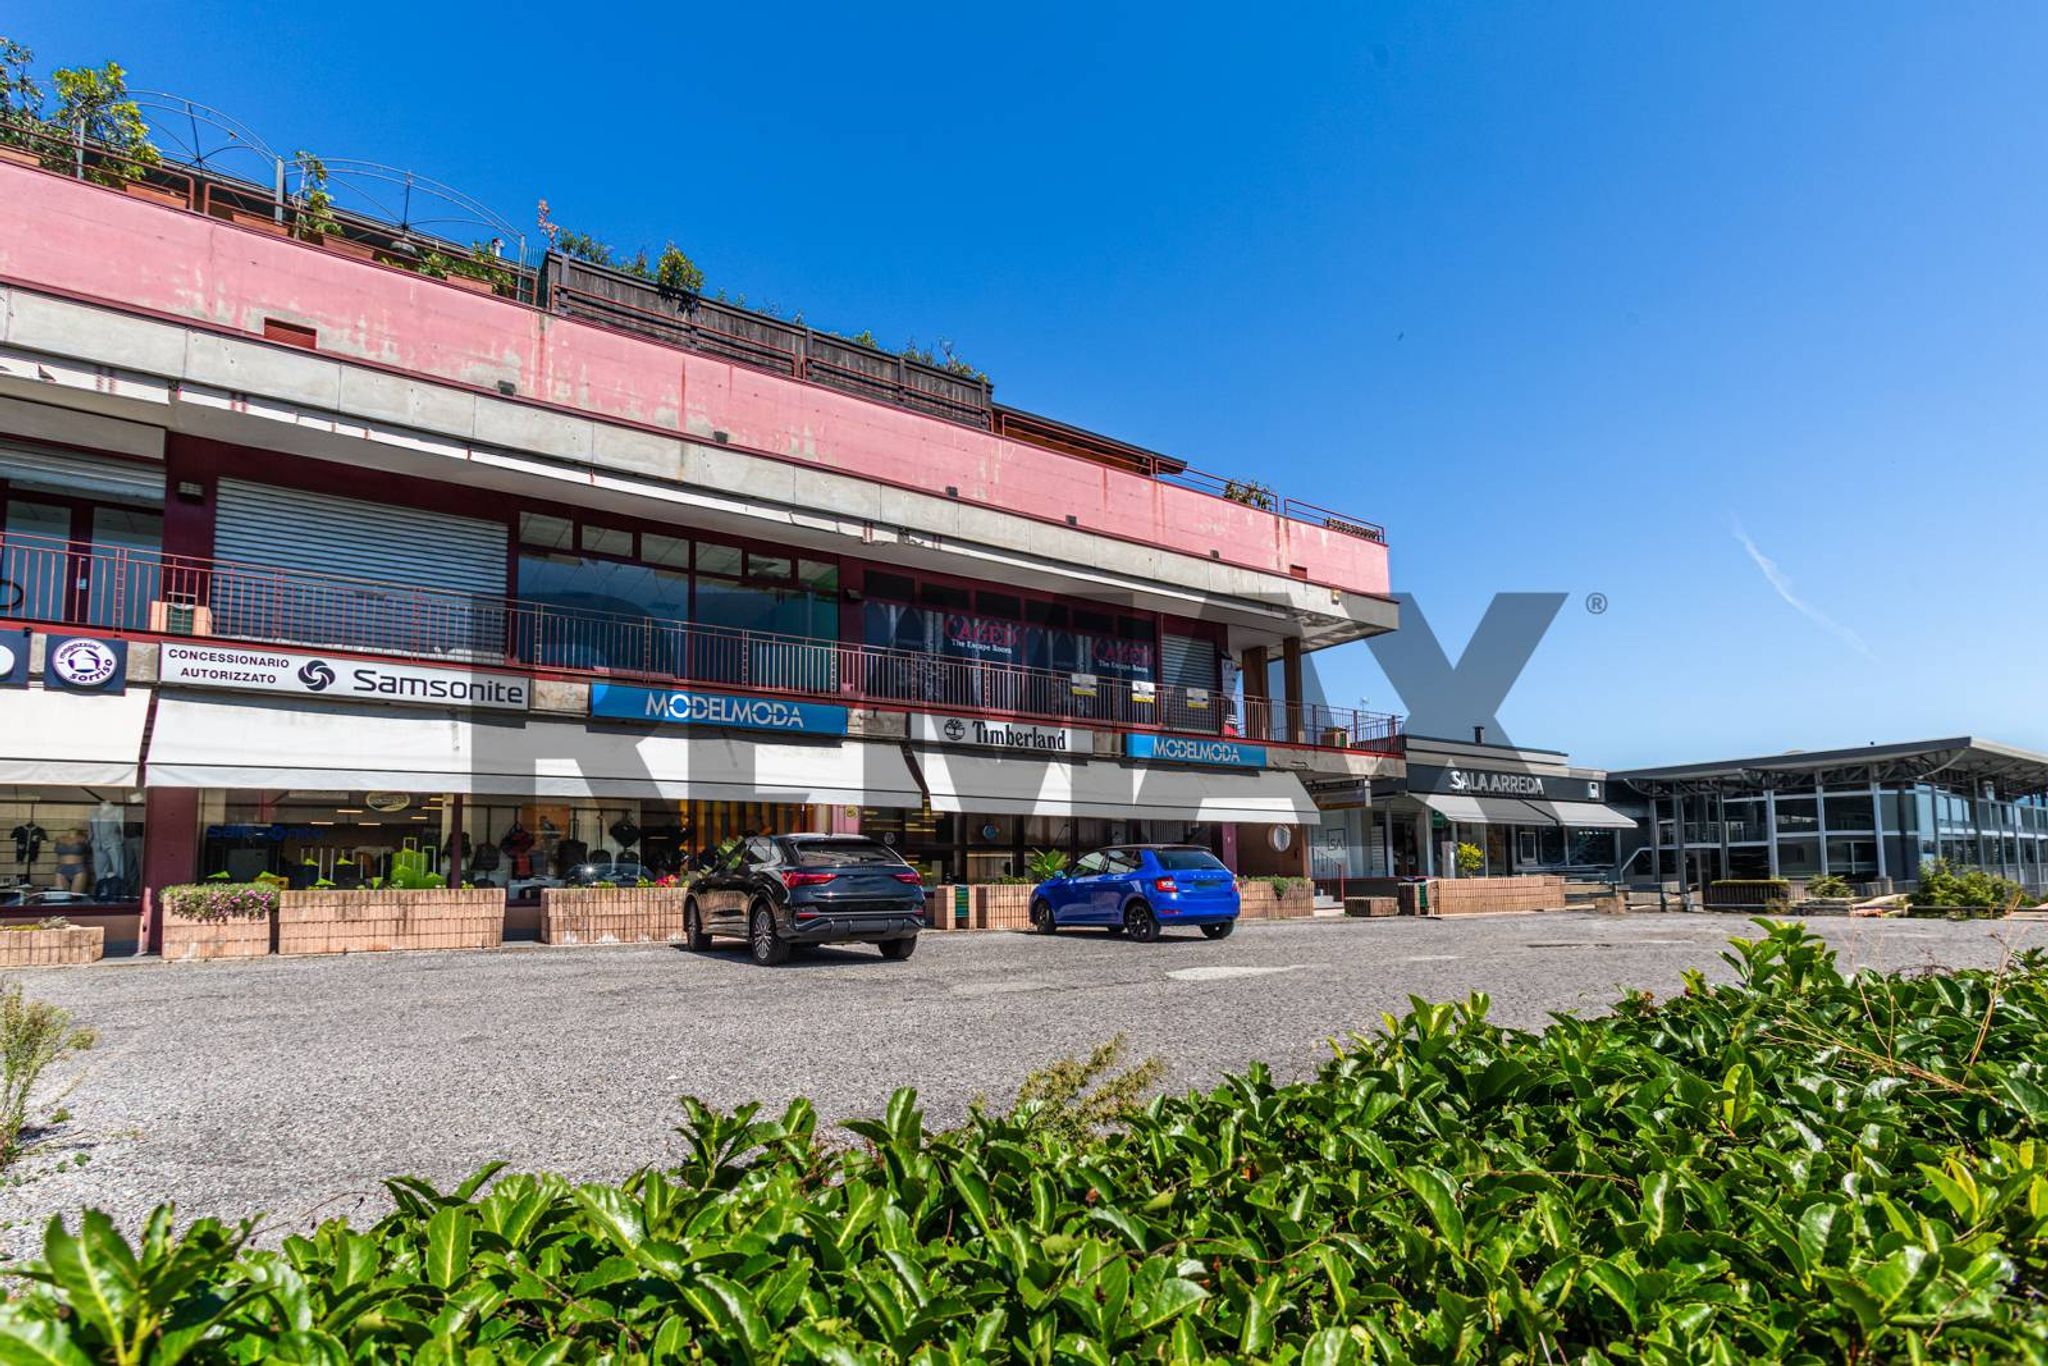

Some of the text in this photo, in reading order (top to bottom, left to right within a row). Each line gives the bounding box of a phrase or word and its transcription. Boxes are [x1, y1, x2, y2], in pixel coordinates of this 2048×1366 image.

[68, 658, 113, 682] sorriso
[168, 648, 290, 669] CONCESSIONARIO
[180, 667, 277, 684] AUTORIZZATO
[353, 669, 524, 704] Samsonite
[645, 691, 804, 728] MODELMODA
[972, 720, 1066, 750] Timberland
[1153, 736, 1241, 763] MODELMODA
